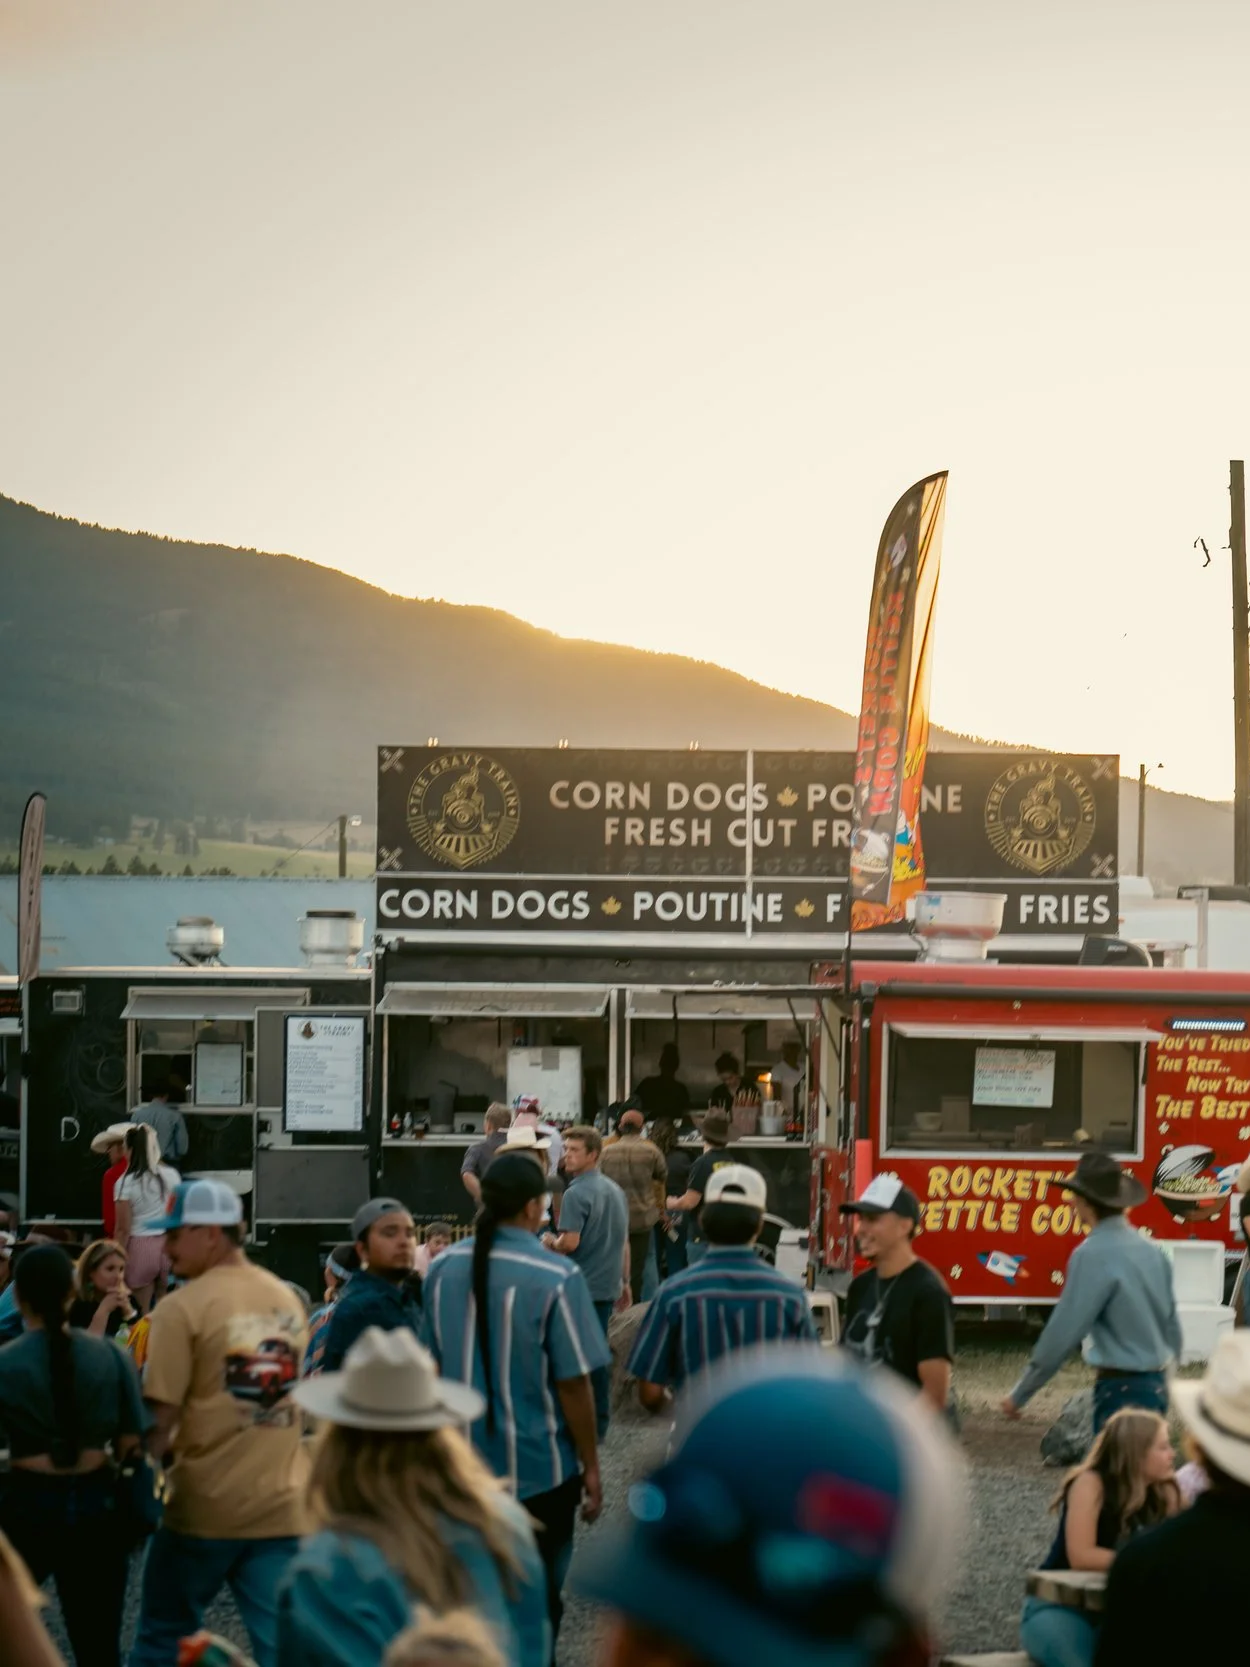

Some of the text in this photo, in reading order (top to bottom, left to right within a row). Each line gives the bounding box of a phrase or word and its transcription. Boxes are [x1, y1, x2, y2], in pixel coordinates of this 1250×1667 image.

[410, 753, 519, 807] THE GRAVY TRAIN
[987, 760, 1095, 812] THE GRAVY TRAIN
[549, 780, 963, 813] CORN DOGS PONE
[604, 818, 711, 847] FRESH
[727, 819, 797, 847] CUT
[379, 889, 783, 922] CORN DOGS POUTINE
[1020, 894, 1111, 924] FRIES
[1156, 1034, 1206, 1051] YOU'VE
[1156, 1055, 1231, 1073] THE REST...
[1186, 1077, 1250, 1094] NOW TRY
[1156, 1095, 1250, 1120] THE BEST
[914, 1200, 1021, 1235] ETTLE
